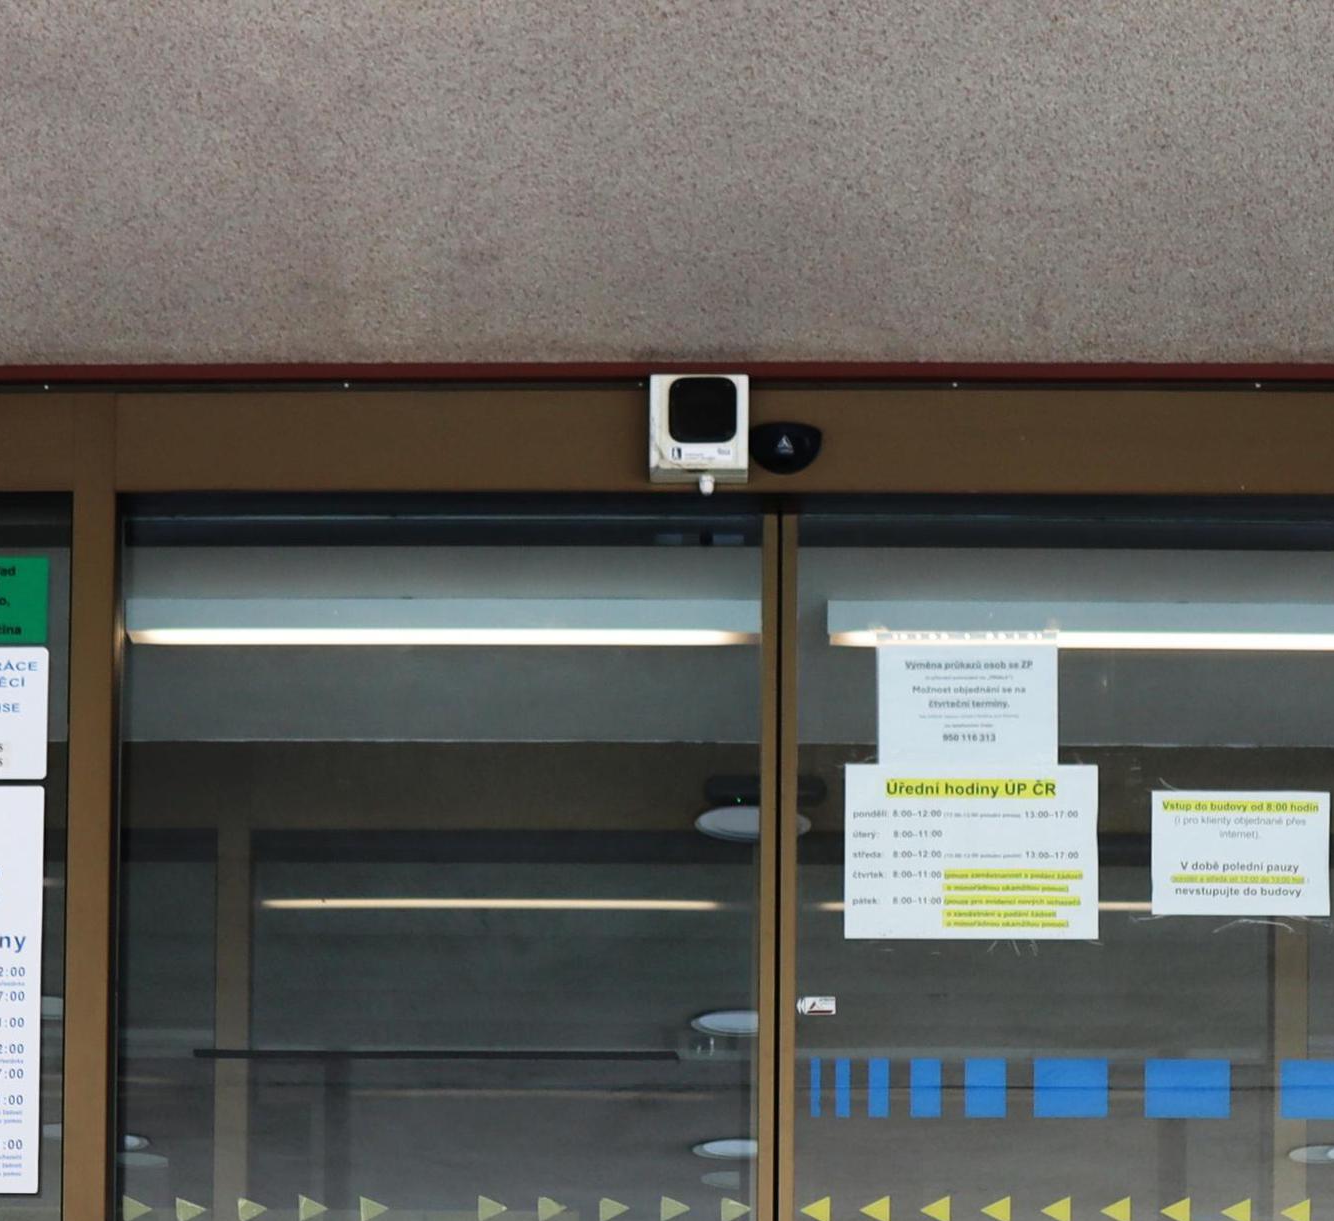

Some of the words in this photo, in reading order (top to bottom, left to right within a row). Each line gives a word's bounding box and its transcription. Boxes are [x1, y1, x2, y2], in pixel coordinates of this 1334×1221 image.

[887, 780, 939, 796] Úřední
[944, 782, 999, 798] hodiny
[1005, 780, 1027, 796] ÚP
[1032, 780, 1056, 796] ČR
[1162, 802, 1192, 812] Vstup
[1195, 802, 1207, 811] do
[1211, 802, 1247, 812] budovy
[1251, 802, 1263, 811] od
[1290, 803, 1319, 812] hodin
[1183, 818, 1199, 826] pro
[1200, 816, 1230, 826] klienty
[1234, 816, 1283, 826] objednané
[1286, 817, 1306, 827] přes
[1181, 862, 1188, 870] V
[1192, 861, 1219, 870] době
[1223, 861, 1264, 872] polední
[1267, 864, 1299, 873] pauzy
[1175, 887, 1239, 897] nevstupujte
[1243, 887, 1257, 896] do
[1261, 887, 1302, 897] budovy
